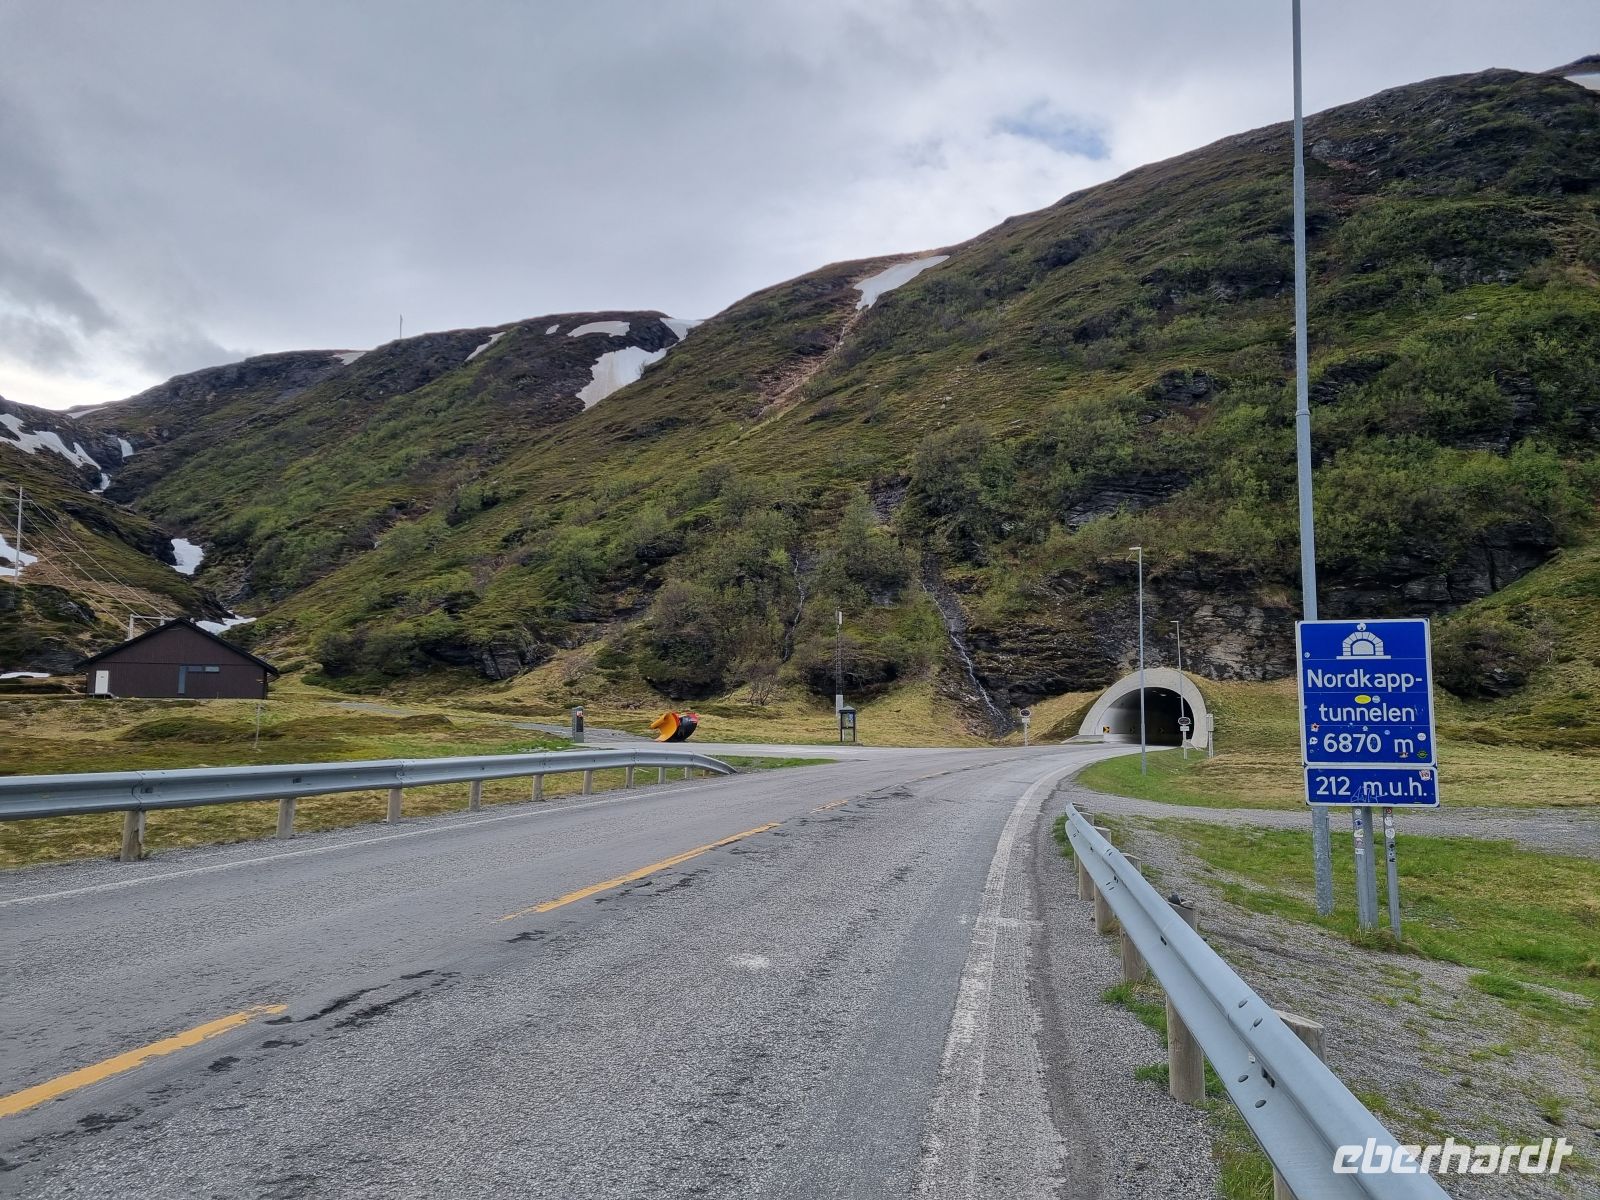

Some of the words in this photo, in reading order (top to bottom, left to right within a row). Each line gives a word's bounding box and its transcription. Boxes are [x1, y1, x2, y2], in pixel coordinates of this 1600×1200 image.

[1307, 669, 1423, 692] Nordkapp-
[1319, 704, 1415, 722] tunnelen
[1323, 733, 1382, 753] 6870
[1394, 738, 1414, 753] m
[1315, 776, 1351, 796] 212
[1363, 777, 1428, 797] m.u.h.
